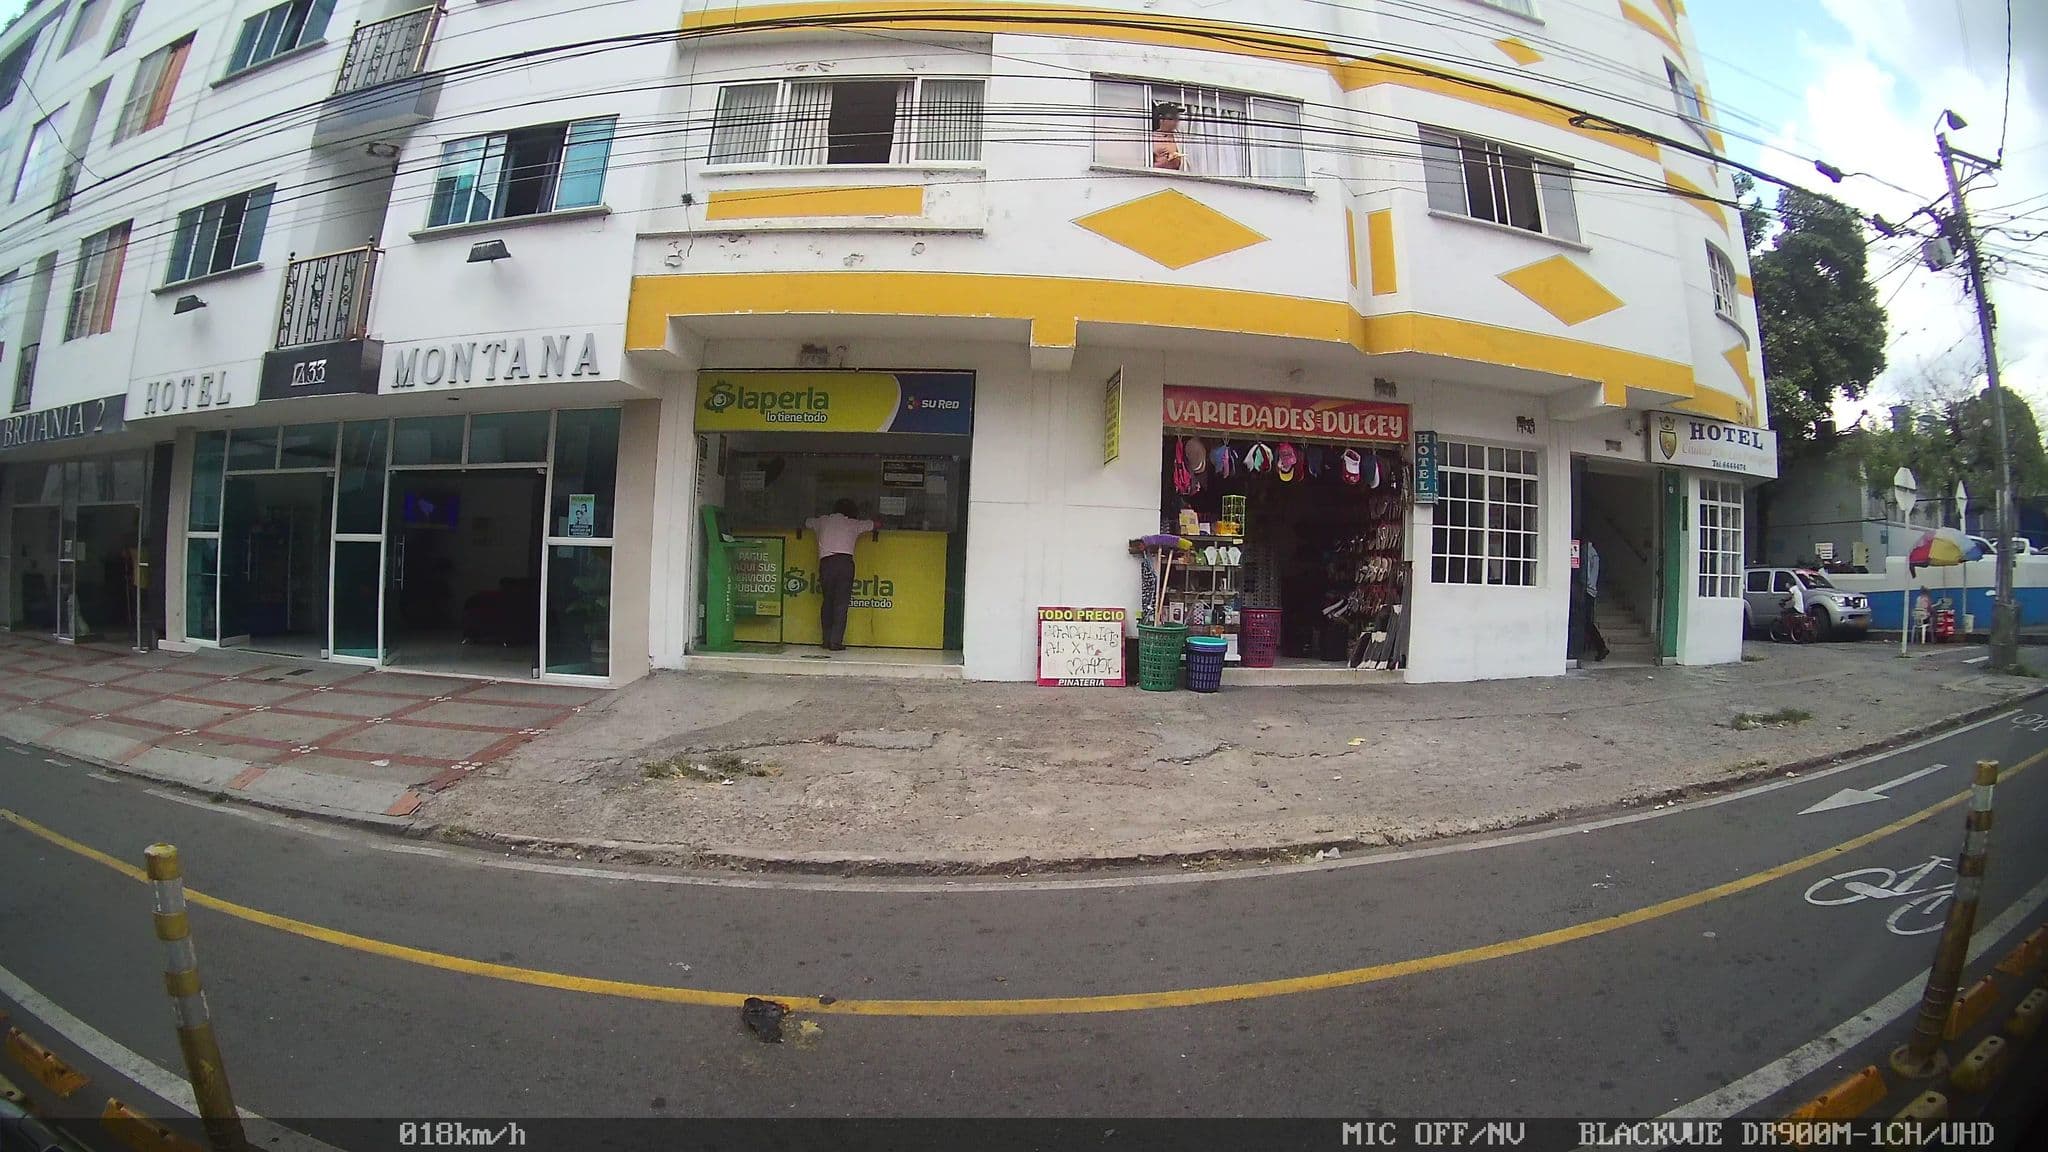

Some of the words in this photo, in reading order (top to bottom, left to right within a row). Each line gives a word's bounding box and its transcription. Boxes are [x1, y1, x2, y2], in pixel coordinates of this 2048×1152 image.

[391, 333, 601, 388] MONTANA
[144, 371, 232, 415] HOTEL
[3, 402, 85, 448] BRITANIA
[94, 399, 106, 433] 2
[767, 411, 777, 422] lo
[777, 411, 802, 422] tiene
[803, 411, 828, 423] todo
[1166, 398, 1316, 432] VARIEDADES
[1323, 410, 1403, 439] DULCEY
[1690, 421, 1763, 450] HOTEL
[1417, 434, 1430, 491] HOTEL
[739, 552, 769, 561] PAGUE
[758, 563, 777, 572] SUS
[871, 597, 893, 608] todo
[1039, 609, 1073, 620] TODO
[1077, 610, 1124, 621] PRECIO
